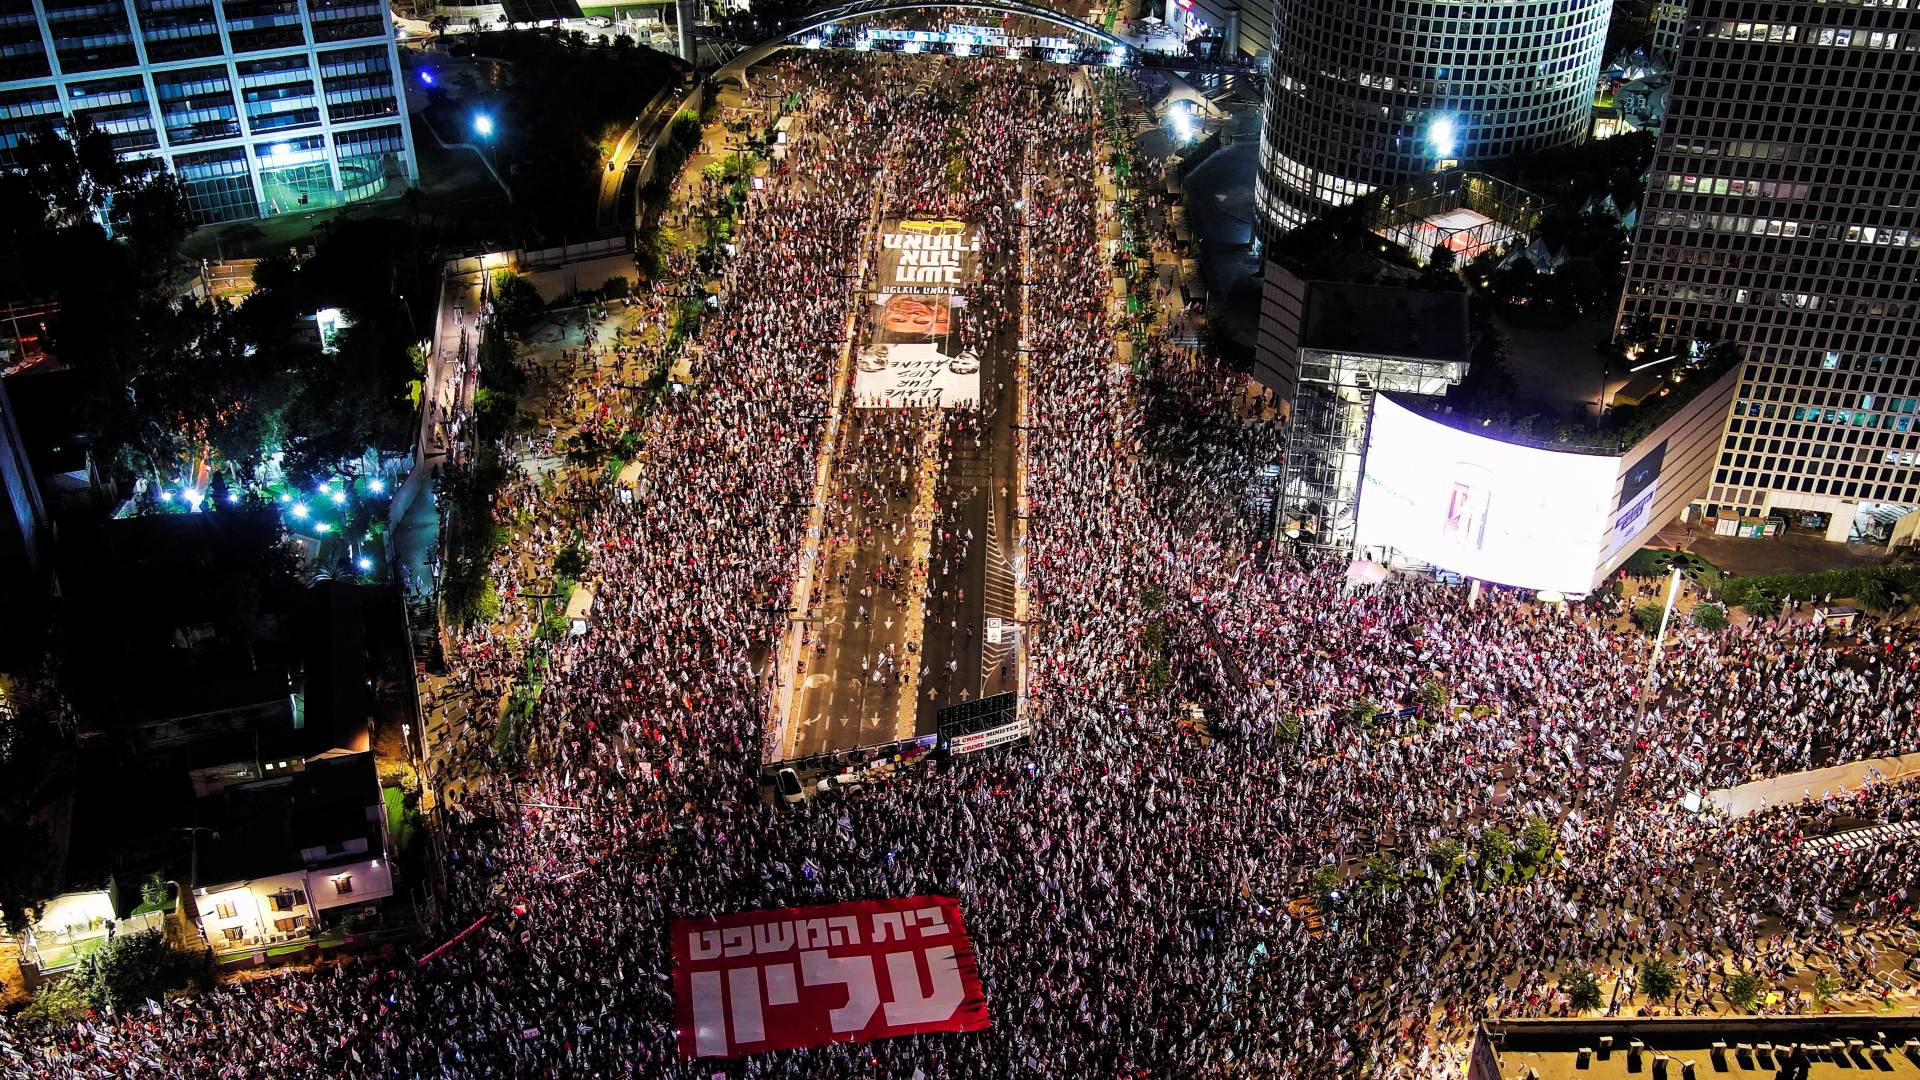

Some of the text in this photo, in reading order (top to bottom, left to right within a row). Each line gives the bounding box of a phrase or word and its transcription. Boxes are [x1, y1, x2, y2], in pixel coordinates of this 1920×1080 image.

[899, 250, 959, 266] אתה
[896, 266, 962, 283] תשב
[883, 286, 959, 295] הפרצוף האמיתי
[890, 359, 949, 369] ALONE
[896, 369, 941, 378] KIDS
[896, 379, 932, 388] OUR
[884, 387, 944, 399] LEAVE
[962, 725, 1019, 743] CRIME MINISTER
[962, 733, 1019, 751] CRIME MINISTER
[688, 905, 950, 961] בית המשפט
[690, 944, 966, 1058] עליון
